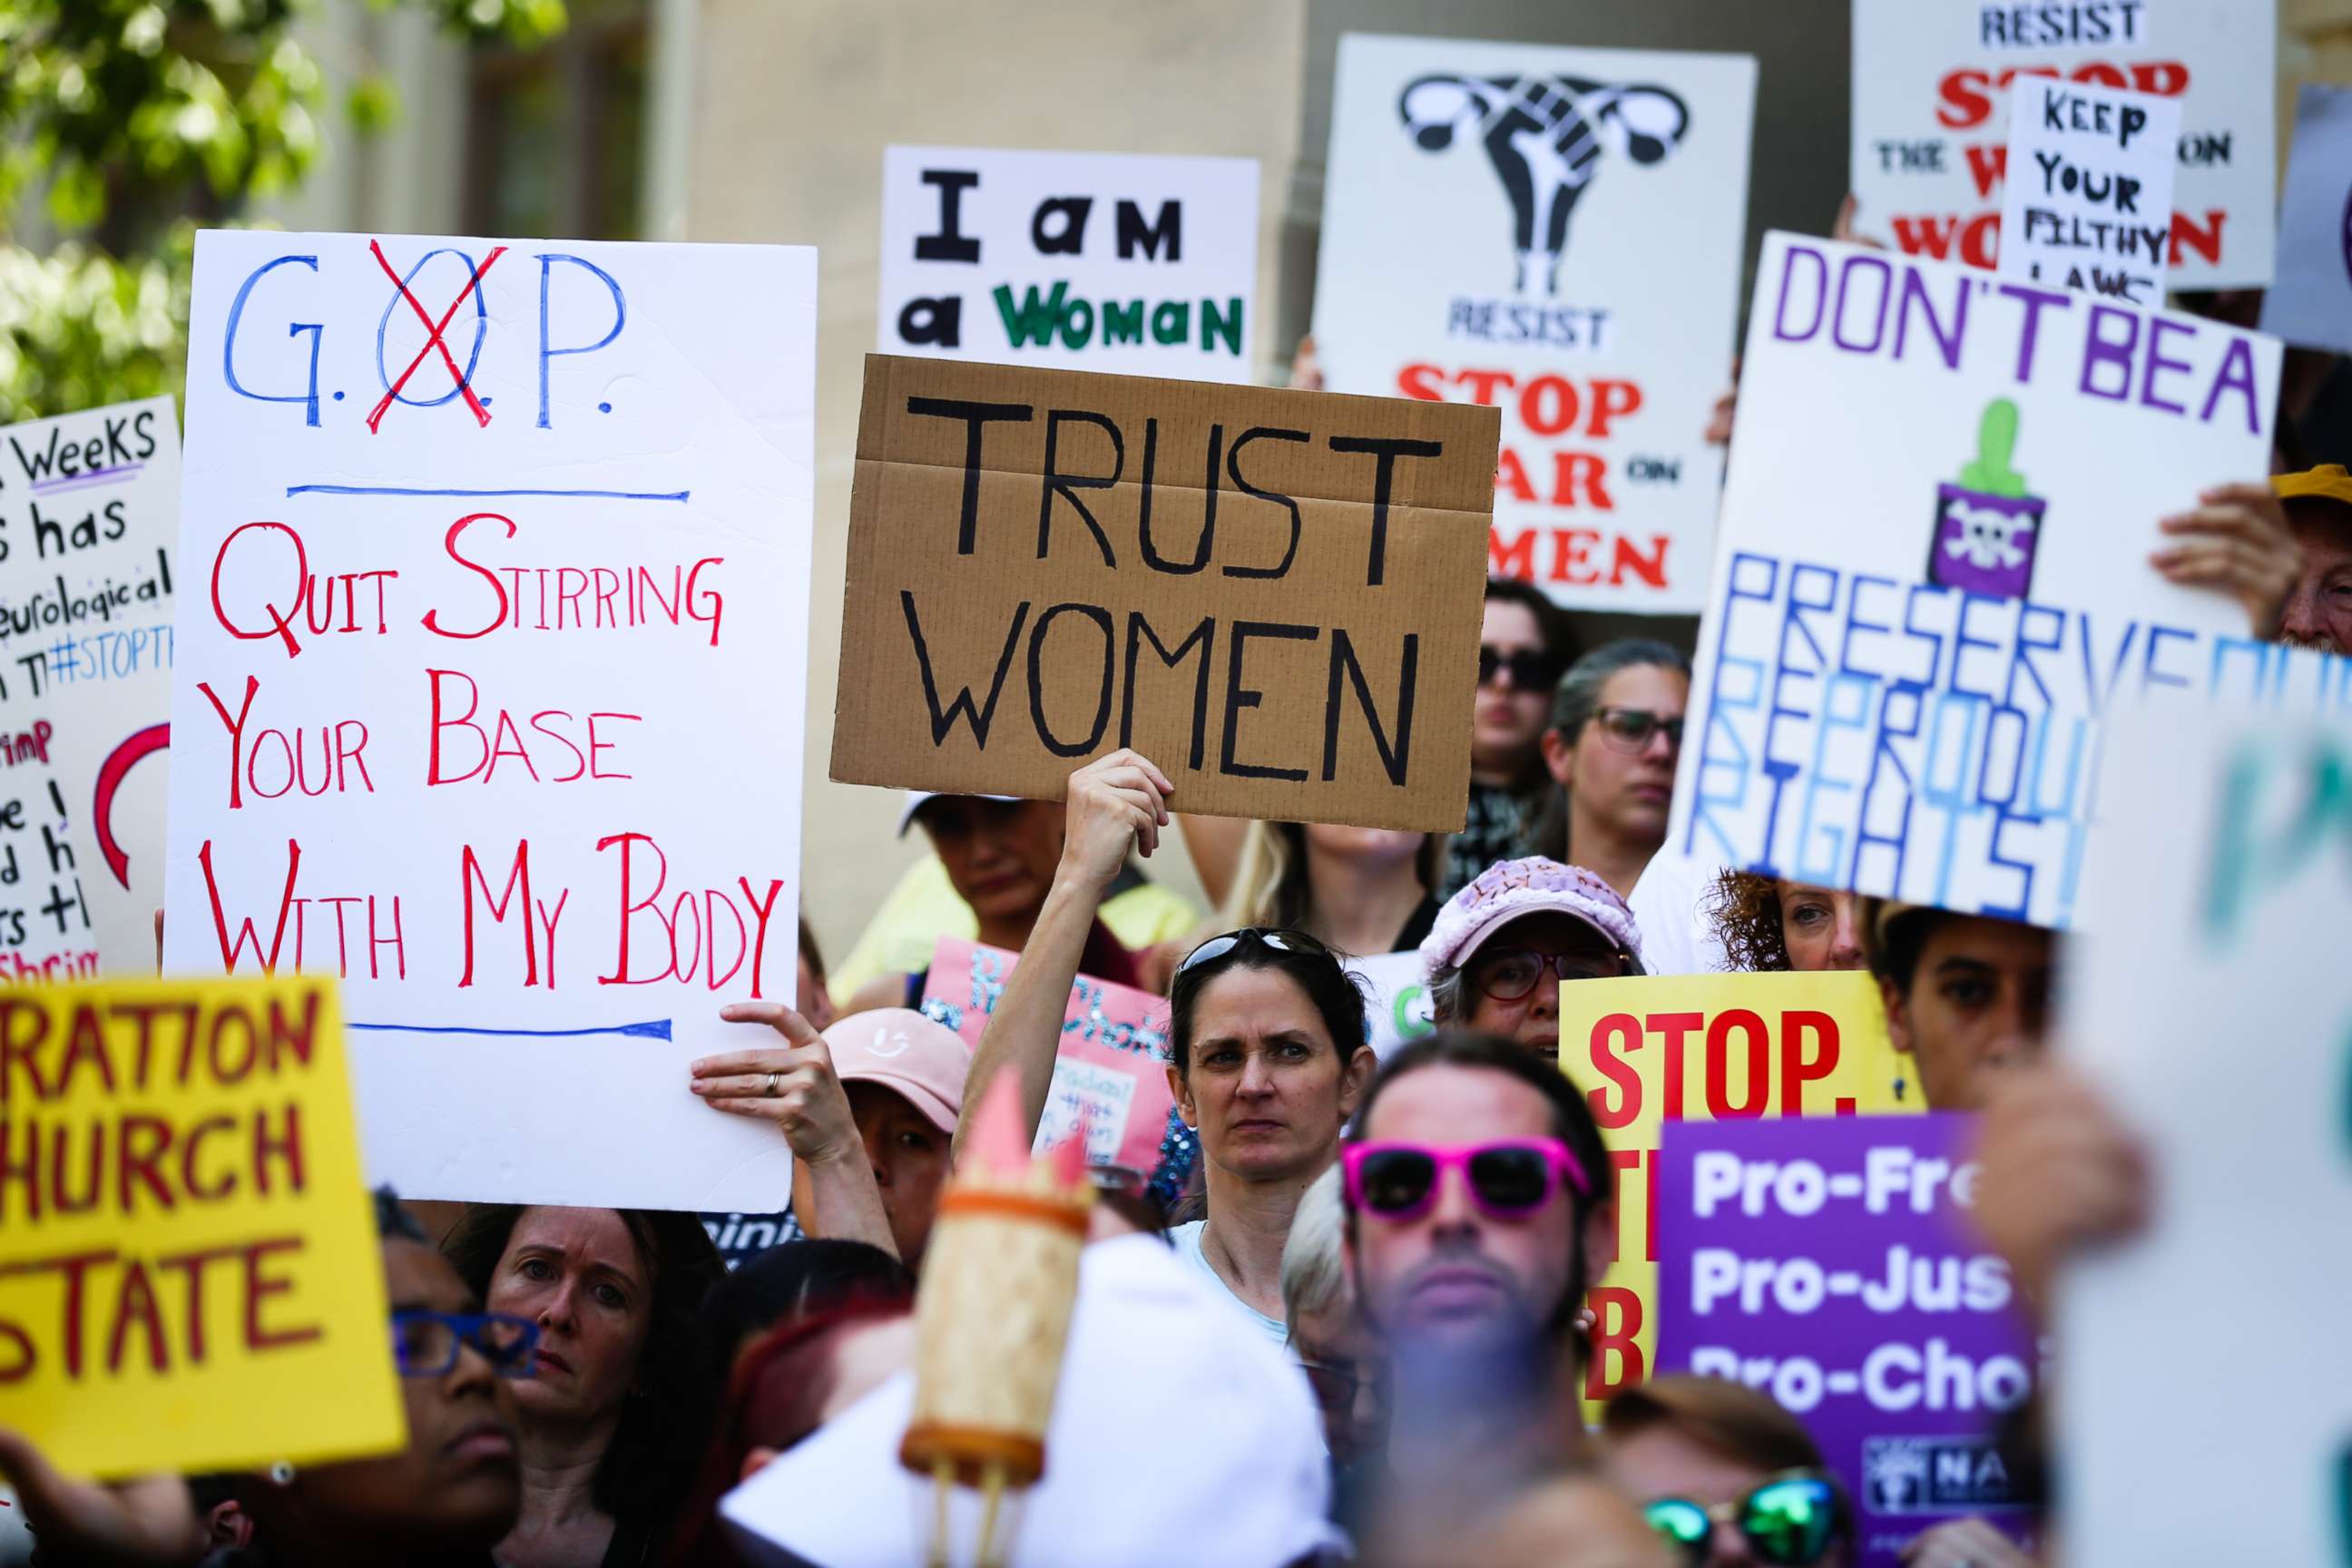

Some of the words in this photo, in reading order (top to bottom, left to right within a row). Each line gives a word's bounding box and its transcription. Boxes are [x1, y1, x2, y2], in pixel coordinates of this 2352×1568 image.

[1980, 2, 2142, 47] RESIST
[1876, 141, 1947, 173] THE
[2179, 132, 2233, 165] ON
[914, 169, 981, 264] I
[2024, 209, 2168, 266] FILTHY
[897, 296, 962, 348] a
[1450, 297, 1610, 348] RESIST
[1773, 246, 2071, 385] DON'T
[907, 397, 1444, 586] TRUST
[1628, 457, 1680, 485] ON
[30, 500, 126, 560] has
[900, 591, 1419, 787] WOMEN
[1699, 652, 2103, 822] REPRODU
[1585, 1008, 1857, 1130] STOP.
